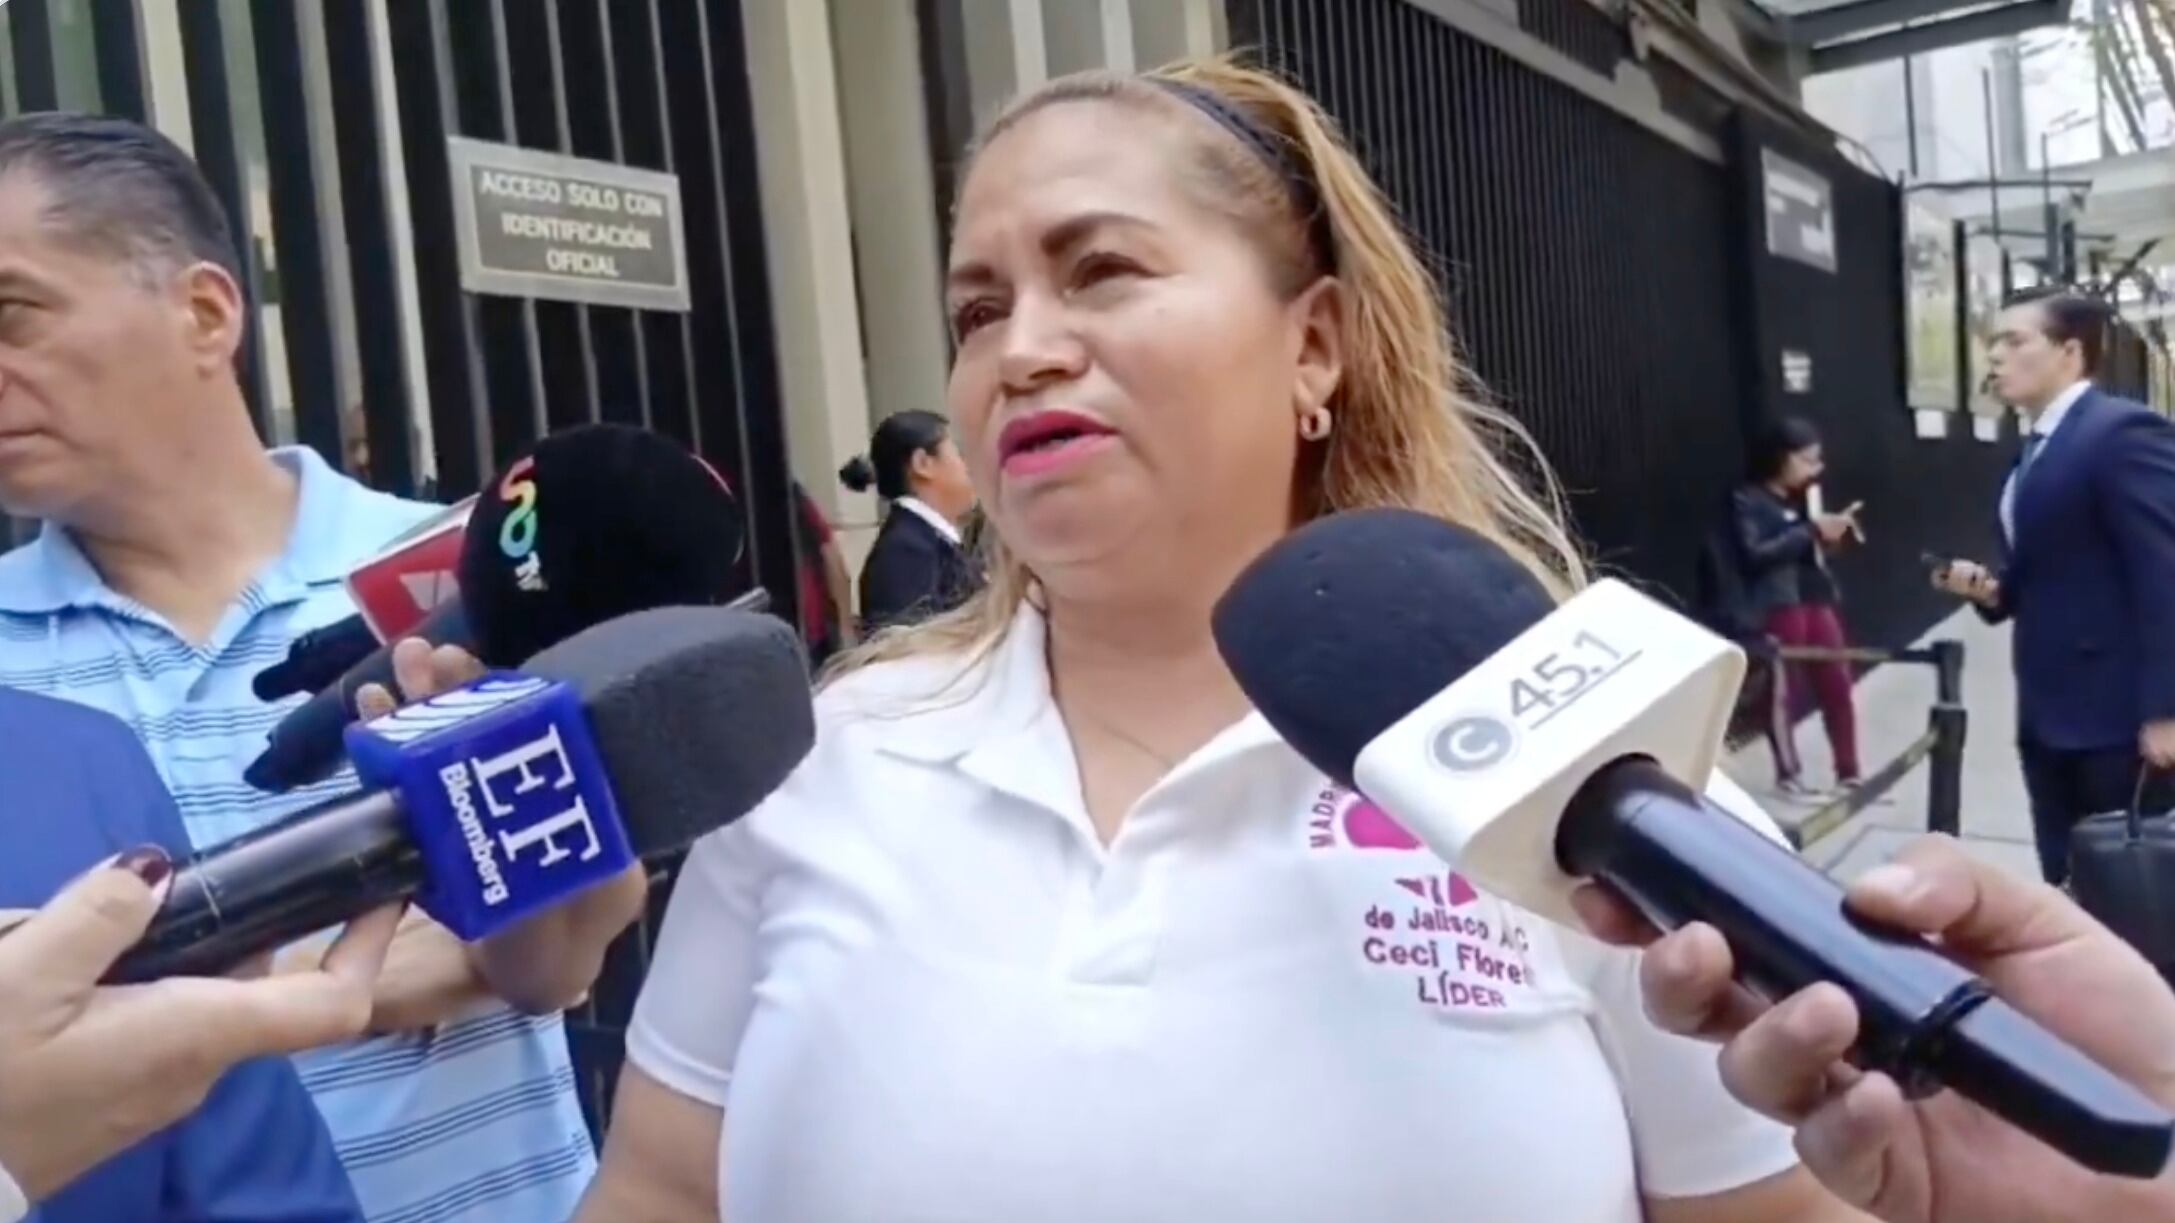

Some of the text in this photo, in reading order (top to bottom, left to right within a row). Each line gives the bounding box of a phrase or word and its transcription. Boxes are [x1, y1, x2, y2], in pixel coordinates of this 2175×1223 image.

[479, 171, 662, 217] ACCESO SOLO CON
[501, 211, 652, 250] IDENTIFICACIÓN
[546, 249, 620, 278] OFICIAL
[1509, 628, 1622, 719] 45.1
[471, 722, 600, 867] EF
[438, 761, 509, 906] Bloomberg
[1364, 904, 1395, 930] de
[1408, 906, 1489, 940] Jalisco
[1363, 937, 1439, 968] Ceci
